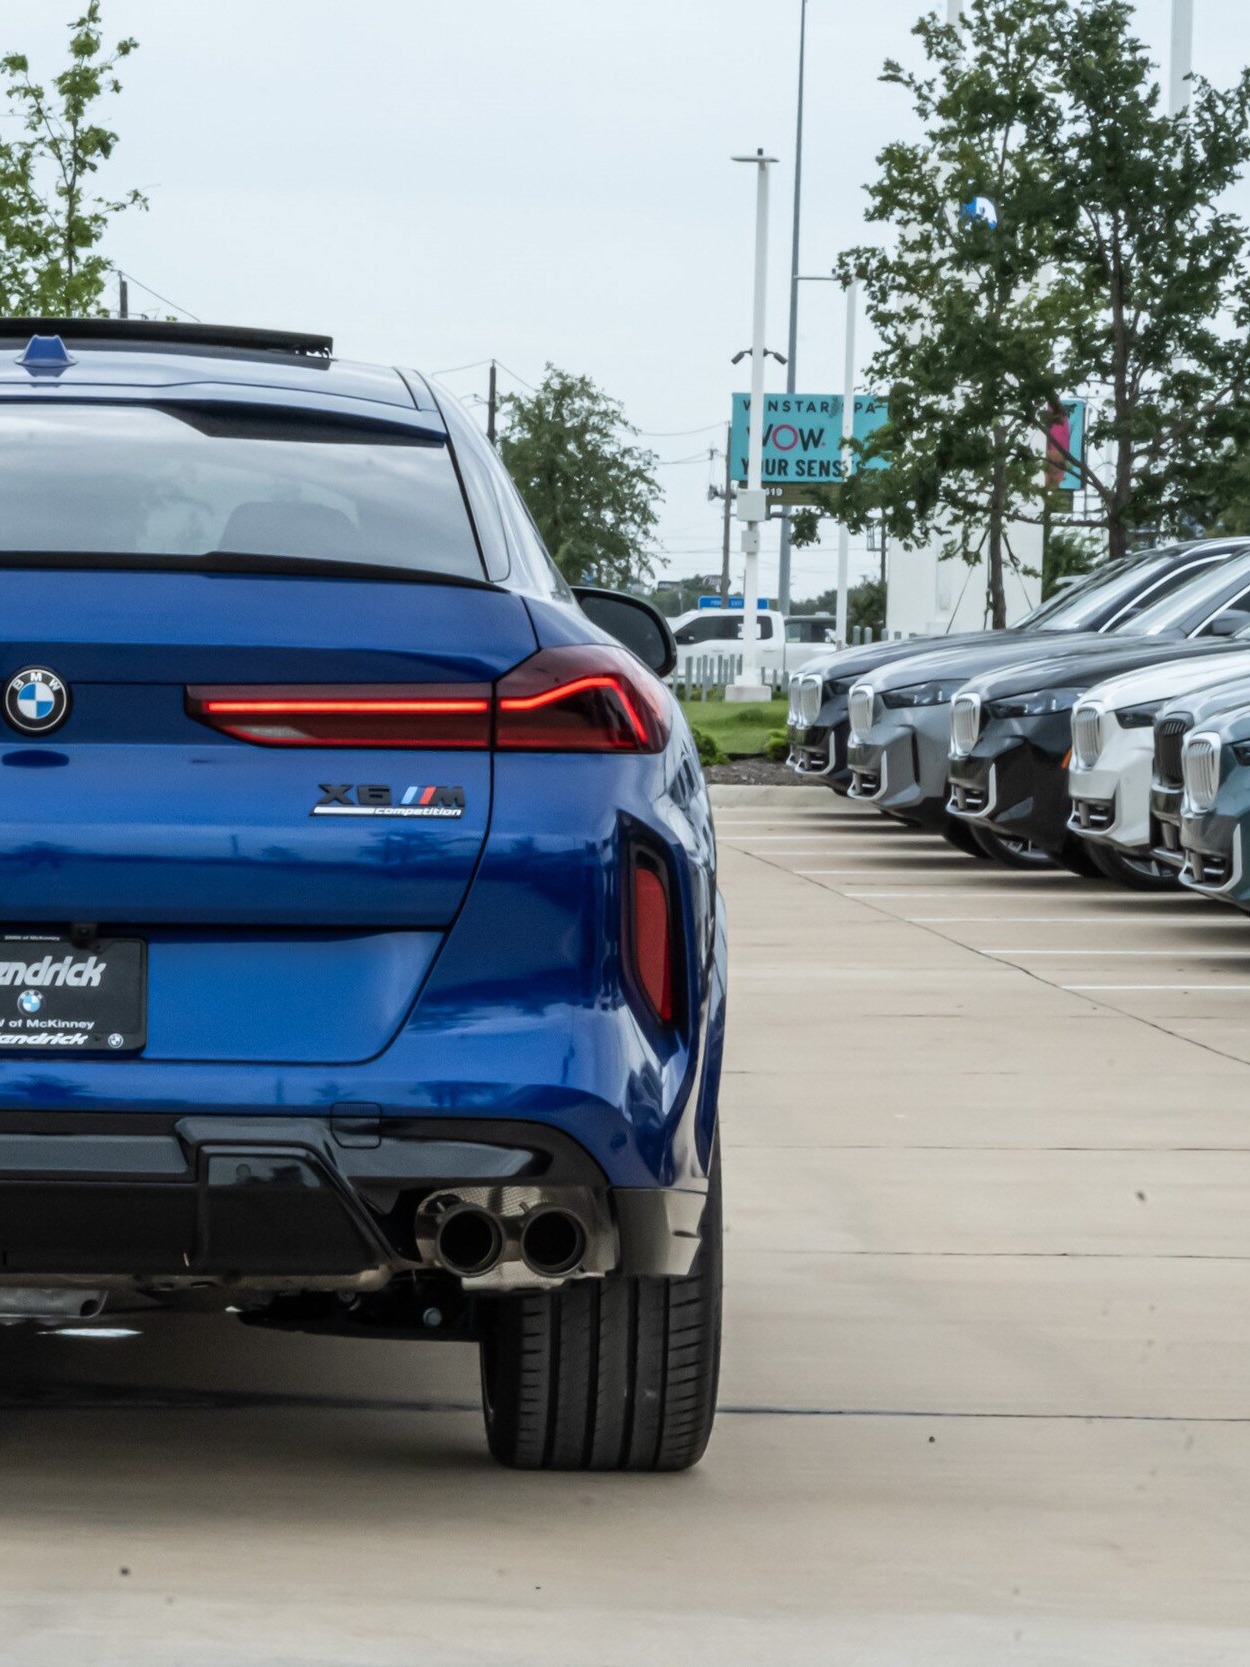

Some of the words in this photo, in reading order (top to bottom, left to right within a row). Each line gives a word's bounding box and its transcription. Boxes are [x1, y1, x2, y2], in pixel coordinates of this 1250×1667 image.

[743, 400, 829, 414] WNSTAR
[841, 402, 875, 414] PA
[741, 458, 789, 476] YUR
[795, 459, 865, 477] SENS
[12, 672, 61, 691] BMW
[317, 784, 392, 805] X6
[374, 807, 462, 816] competition
[9, 1019, 23, 1028] of
[26, 1019, 95, 1030] McKinney
